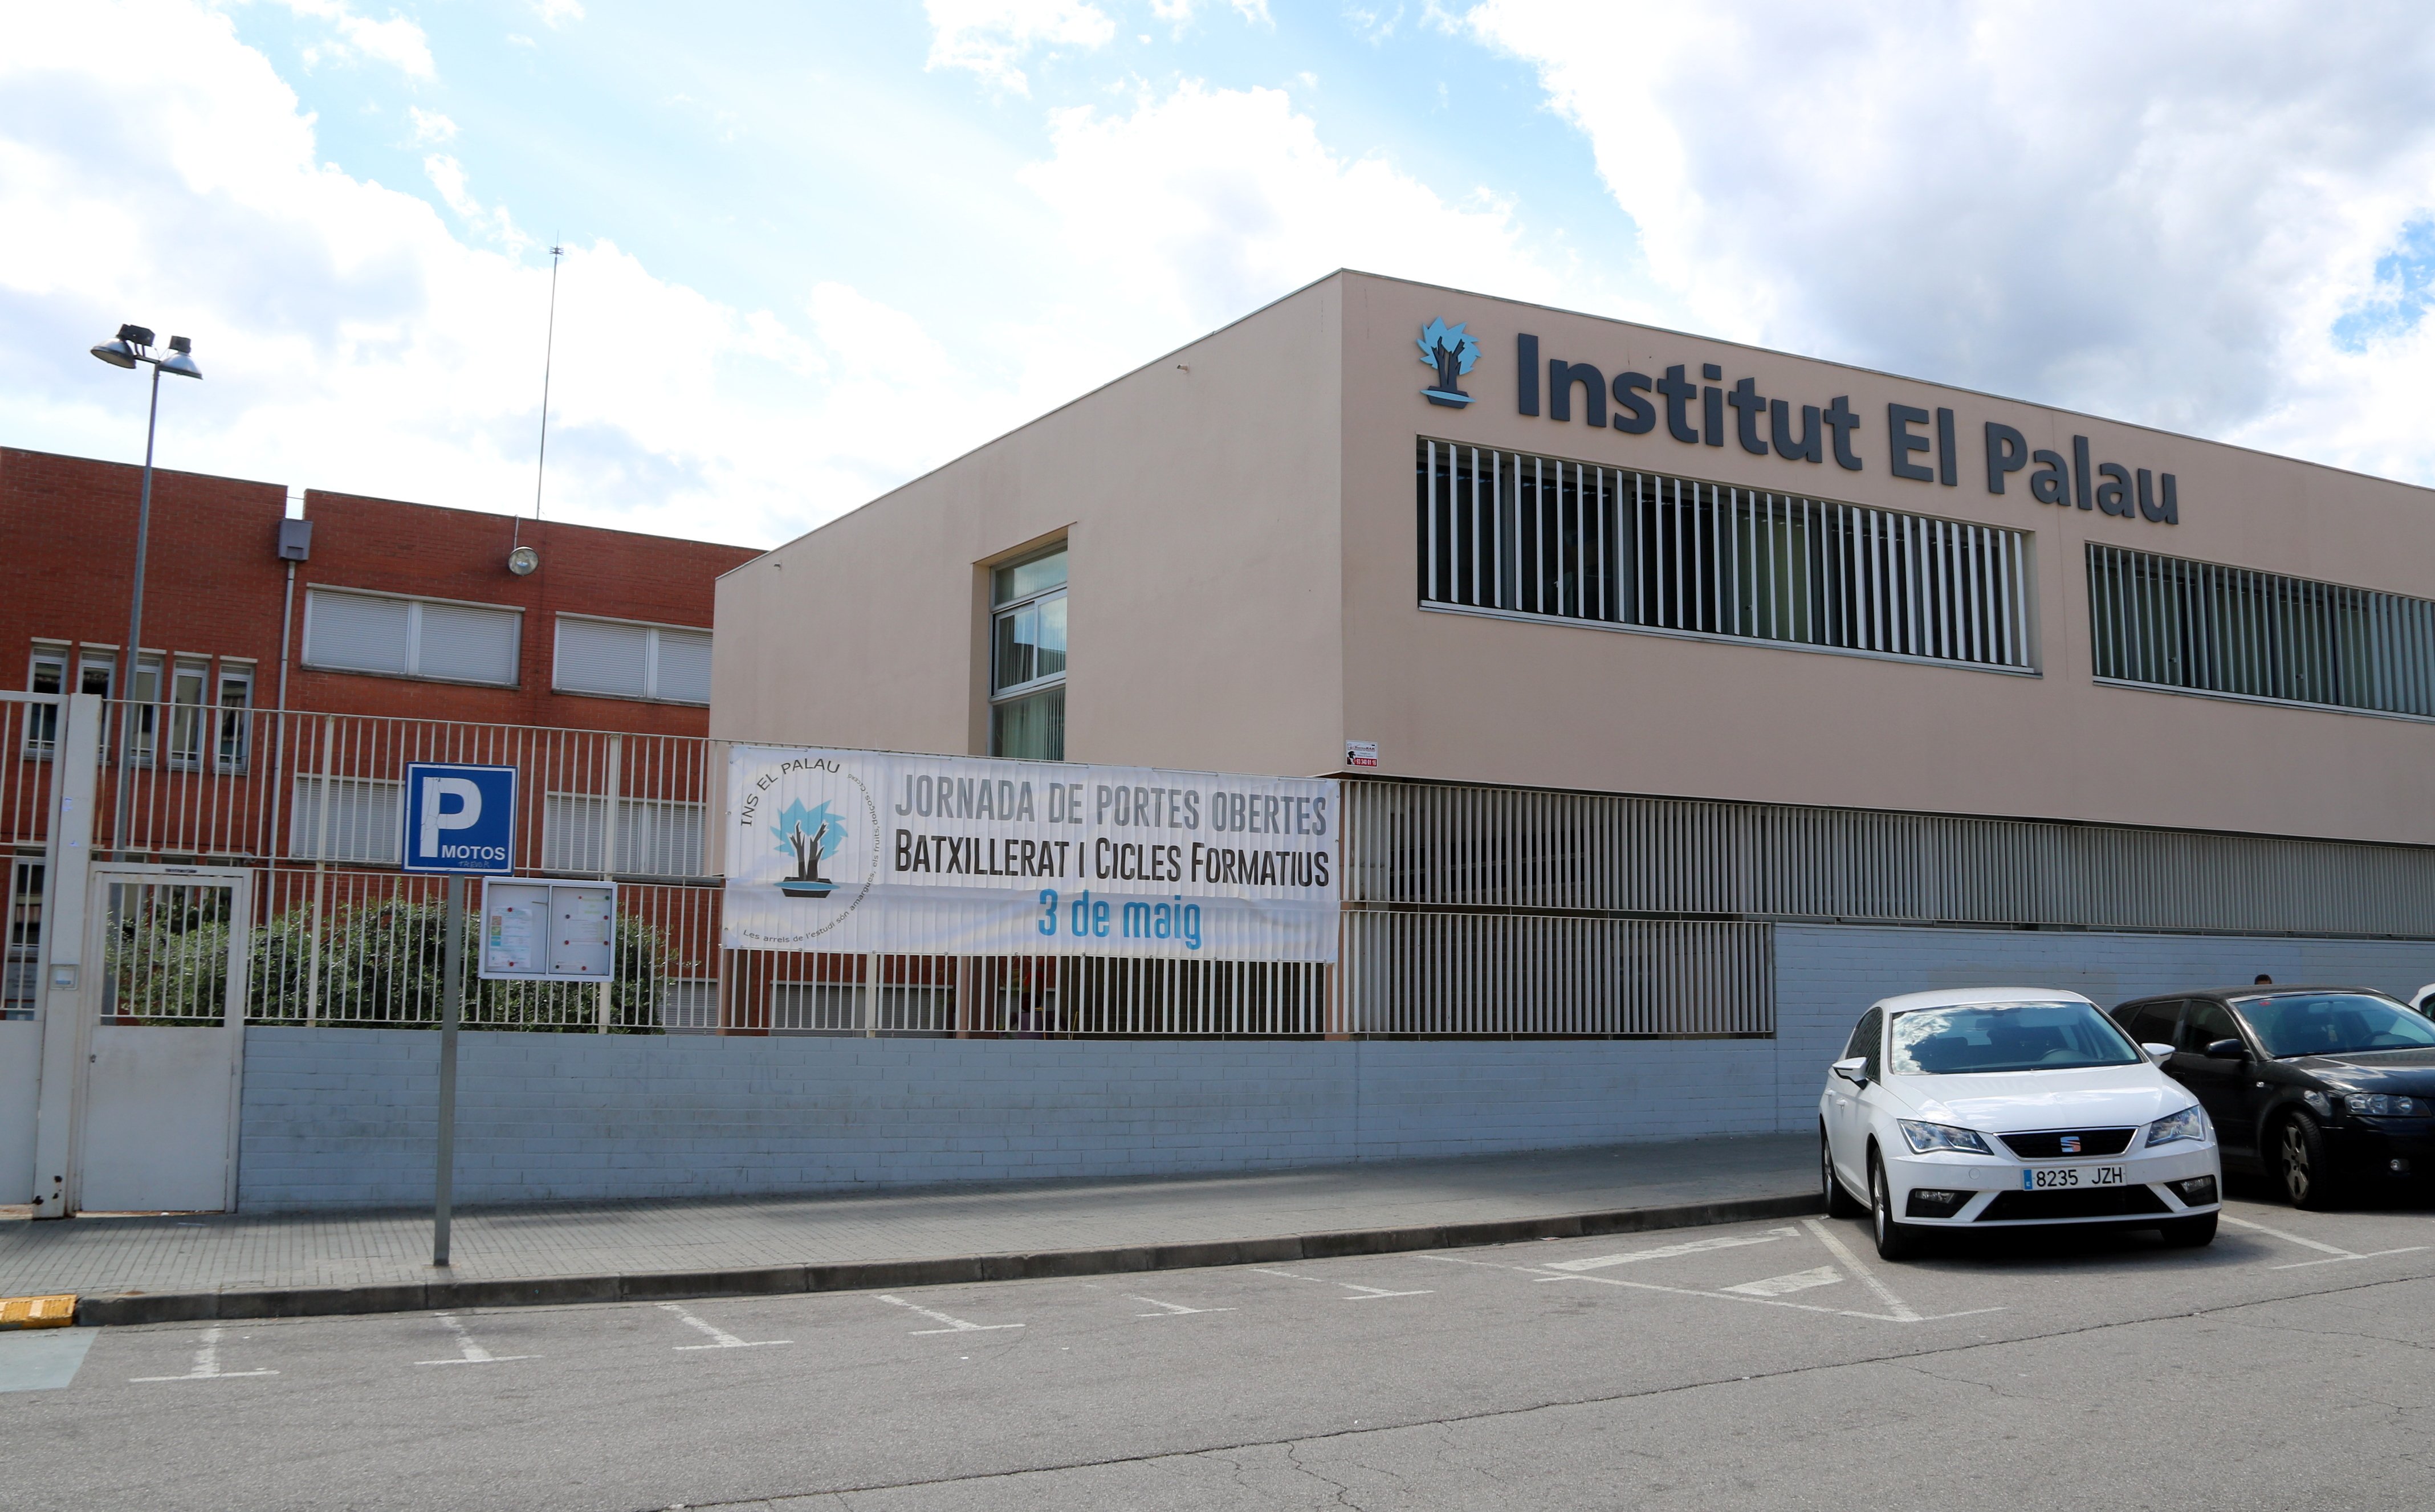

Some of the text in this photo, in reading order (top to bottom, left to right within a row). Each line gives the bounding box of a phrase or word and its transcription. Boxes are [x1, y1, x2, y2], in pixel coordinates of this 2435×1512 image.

[1517, 332, 2179, 525] Institut El Palau
[420, 776, 482, 858] P
[741, 758, 840, 826] INS EL PALAU
[895, 775, 1327, 836] JORNADA DE PORTES OBERTES
[441, 845, 506, 861] MOTOS
[895, 829, 1069, 878] BATXILLERAT
[1096, 837, 1181, 882] CICLES
[1191, 842, 1329, 887] FORMATIUS
[743, 930, 760, 940] Les
[836, 911, 849, 924] són
[1038, 888, 1202, 950] 3 de maig
[2036, 1167, 2122, 1187] 8235 JZH
